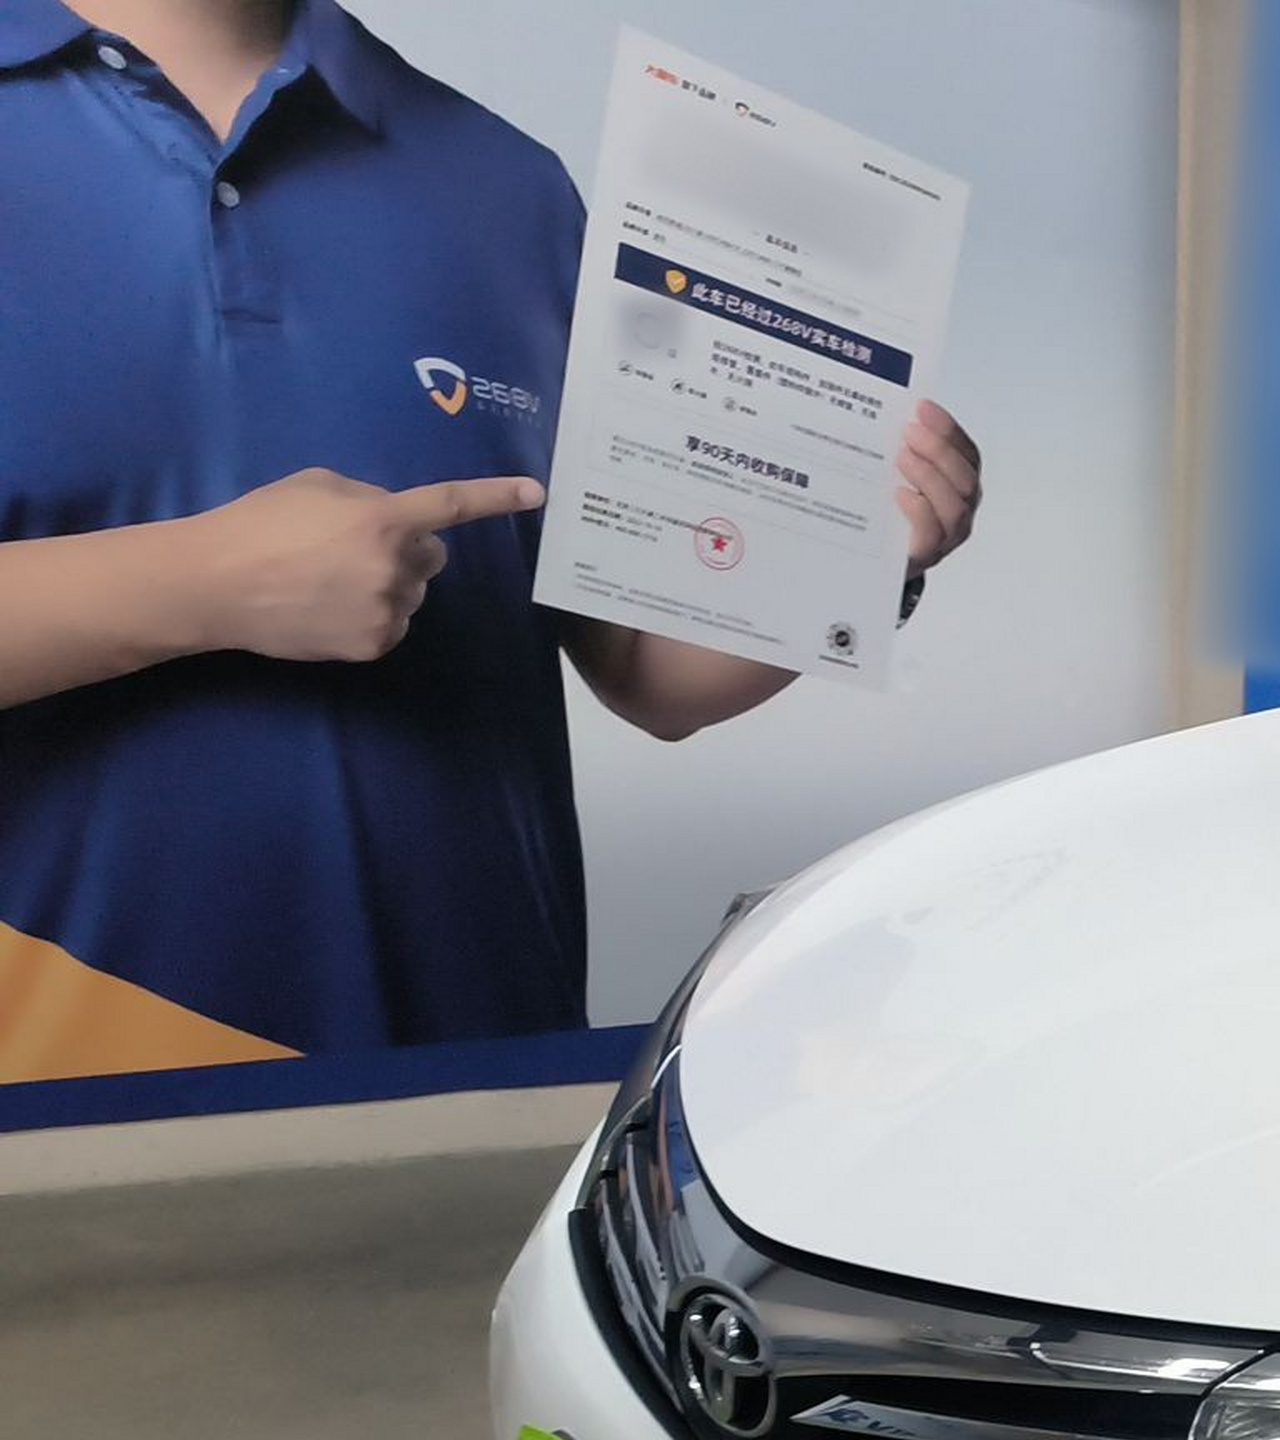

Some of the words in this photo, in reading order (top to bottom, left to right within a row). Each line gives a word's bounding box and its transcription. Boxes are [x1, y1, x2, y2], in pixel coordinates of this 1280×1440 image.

[691, 282, 874, 365] 此车已经过268V实车检测
[684, 433, 811, 490] 享90天内收购保障
